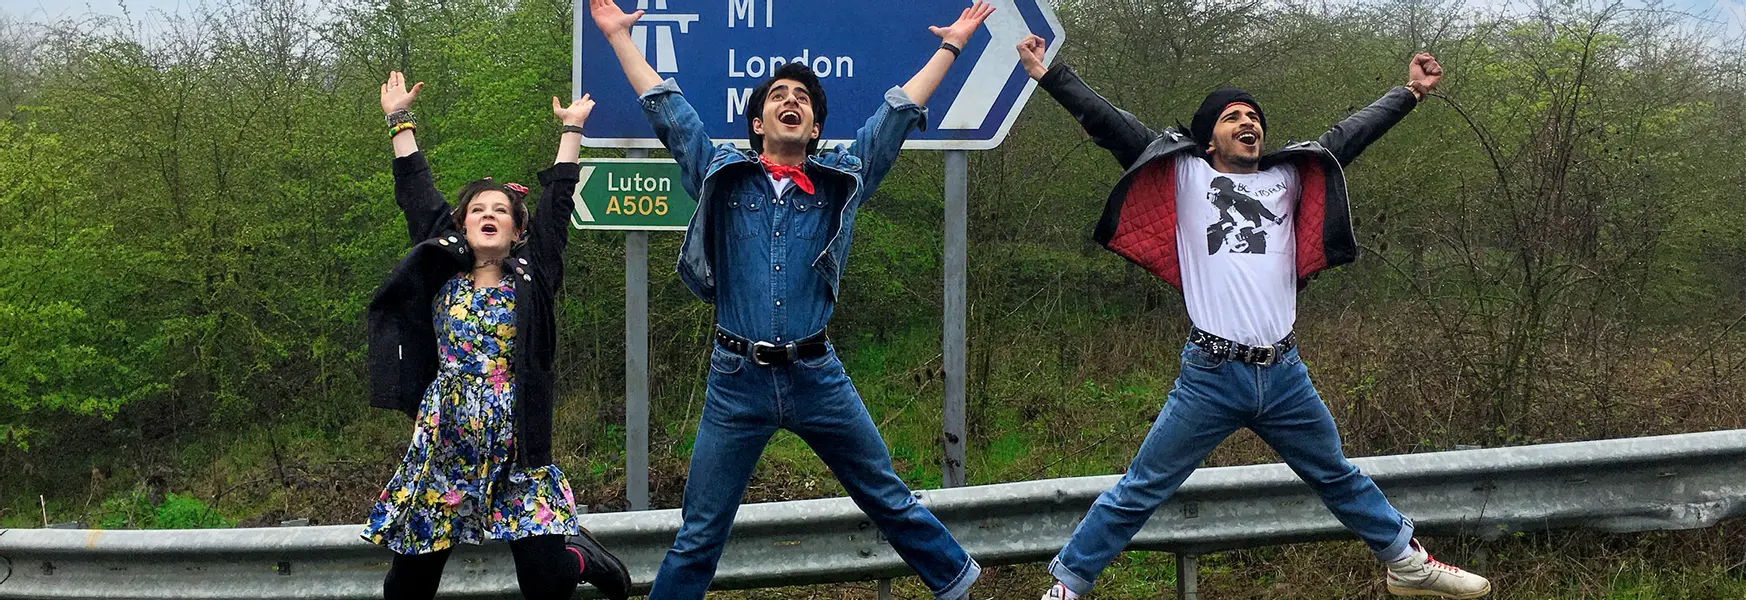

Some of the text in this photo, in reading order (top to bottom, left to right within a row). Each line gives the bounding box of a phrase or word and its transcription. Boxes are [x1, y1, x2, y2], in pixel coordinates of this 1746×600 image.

[728, 0, 773, 28] M1
[607, 172, 671, 192] Luton
[605, 195, 669, 216] A505
